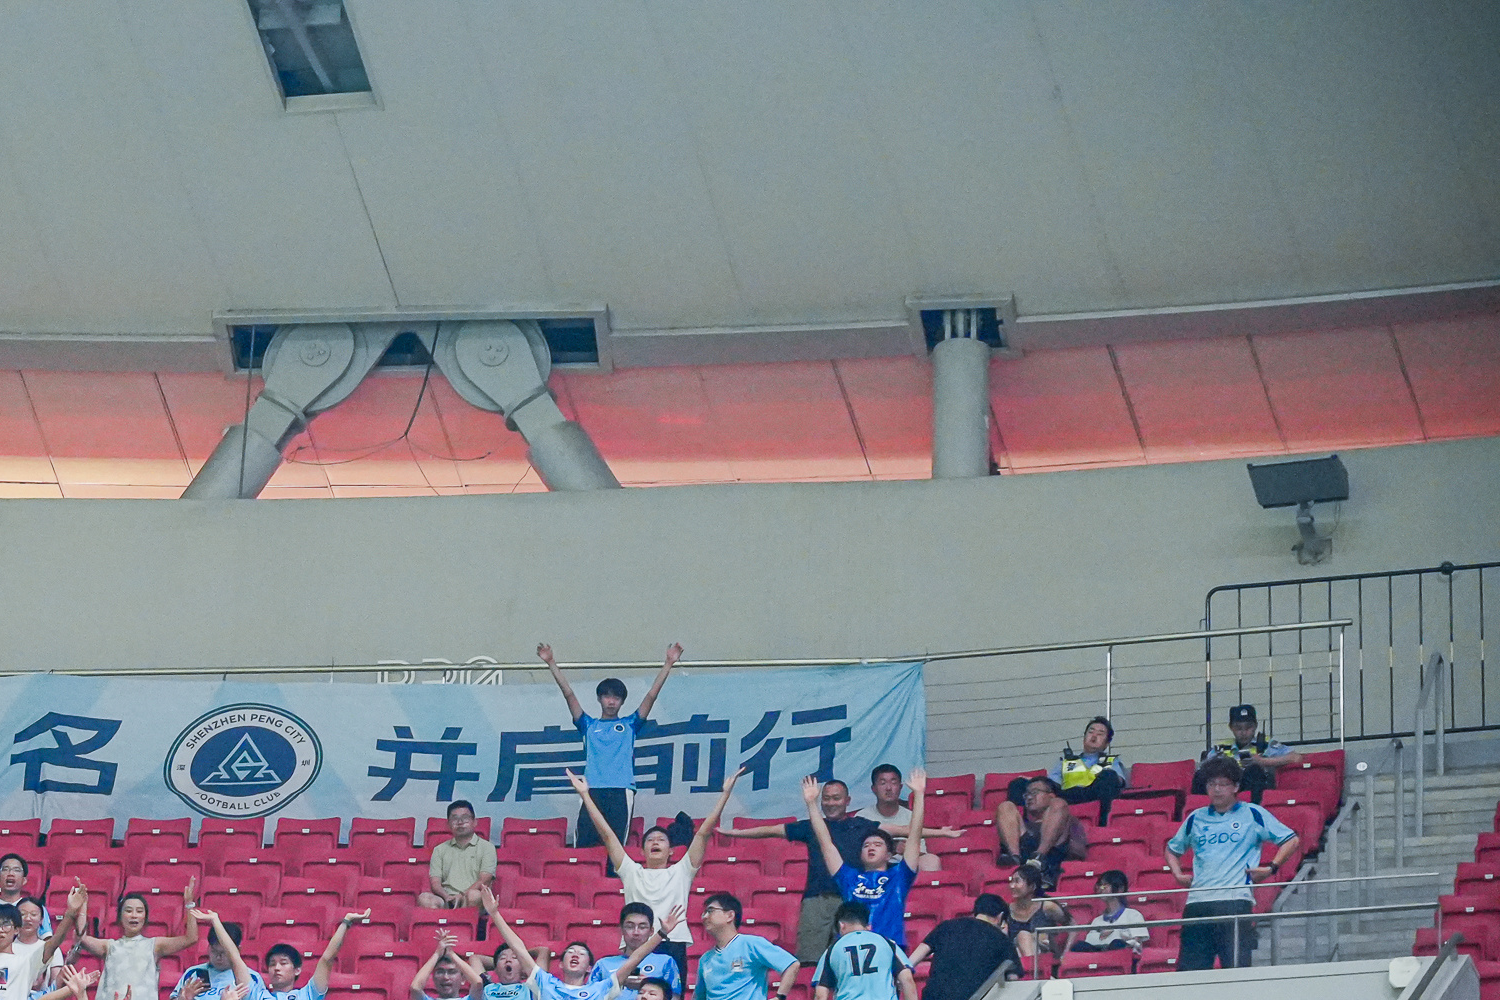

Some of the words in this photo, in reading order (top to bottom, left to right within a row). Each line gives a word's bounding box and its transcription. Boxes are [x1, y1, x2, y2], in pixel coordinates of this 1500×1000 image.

[185, 713, 247, 750] SHENZHEN
[250, 713, 284, 729] PENG
[284, 724, 307, 745] CITY
[843, 943, 879, 977] 12
